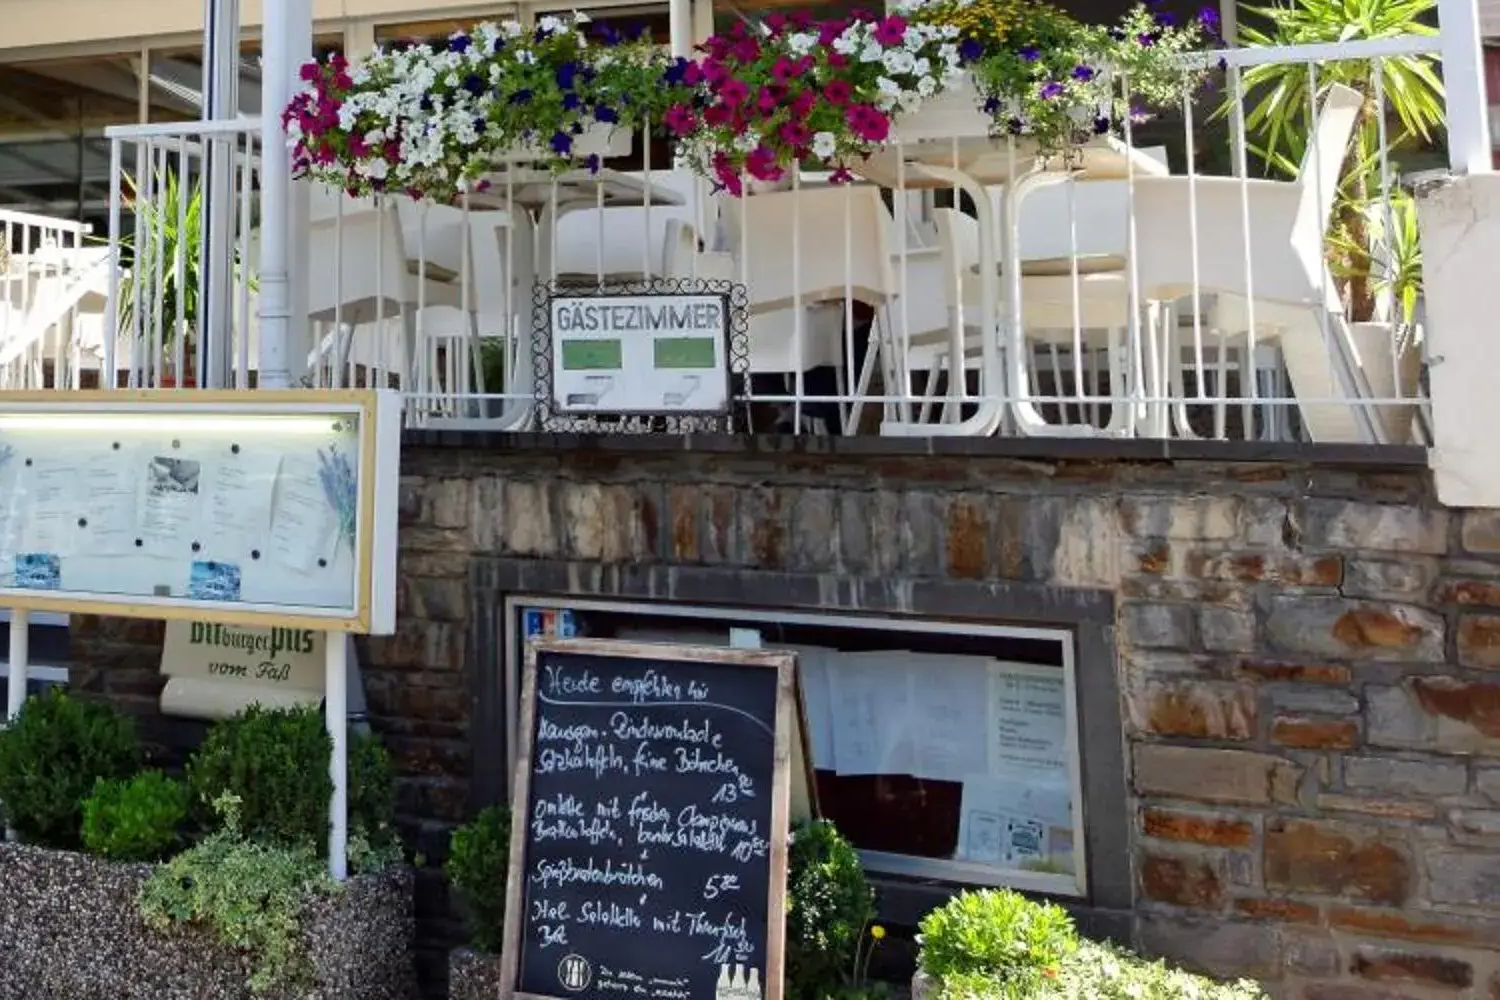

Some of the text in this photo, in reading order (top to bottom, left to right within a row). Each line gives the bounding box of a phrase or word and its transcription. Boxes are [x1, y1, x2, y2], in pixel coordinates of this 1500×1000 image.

[557, 302, 720, 331] GÄSTEZIMMER
[208, 661, 291, 683] vom Faß
[597, 797, 621, 818] mit
[653, 911, 681, 933] mit
